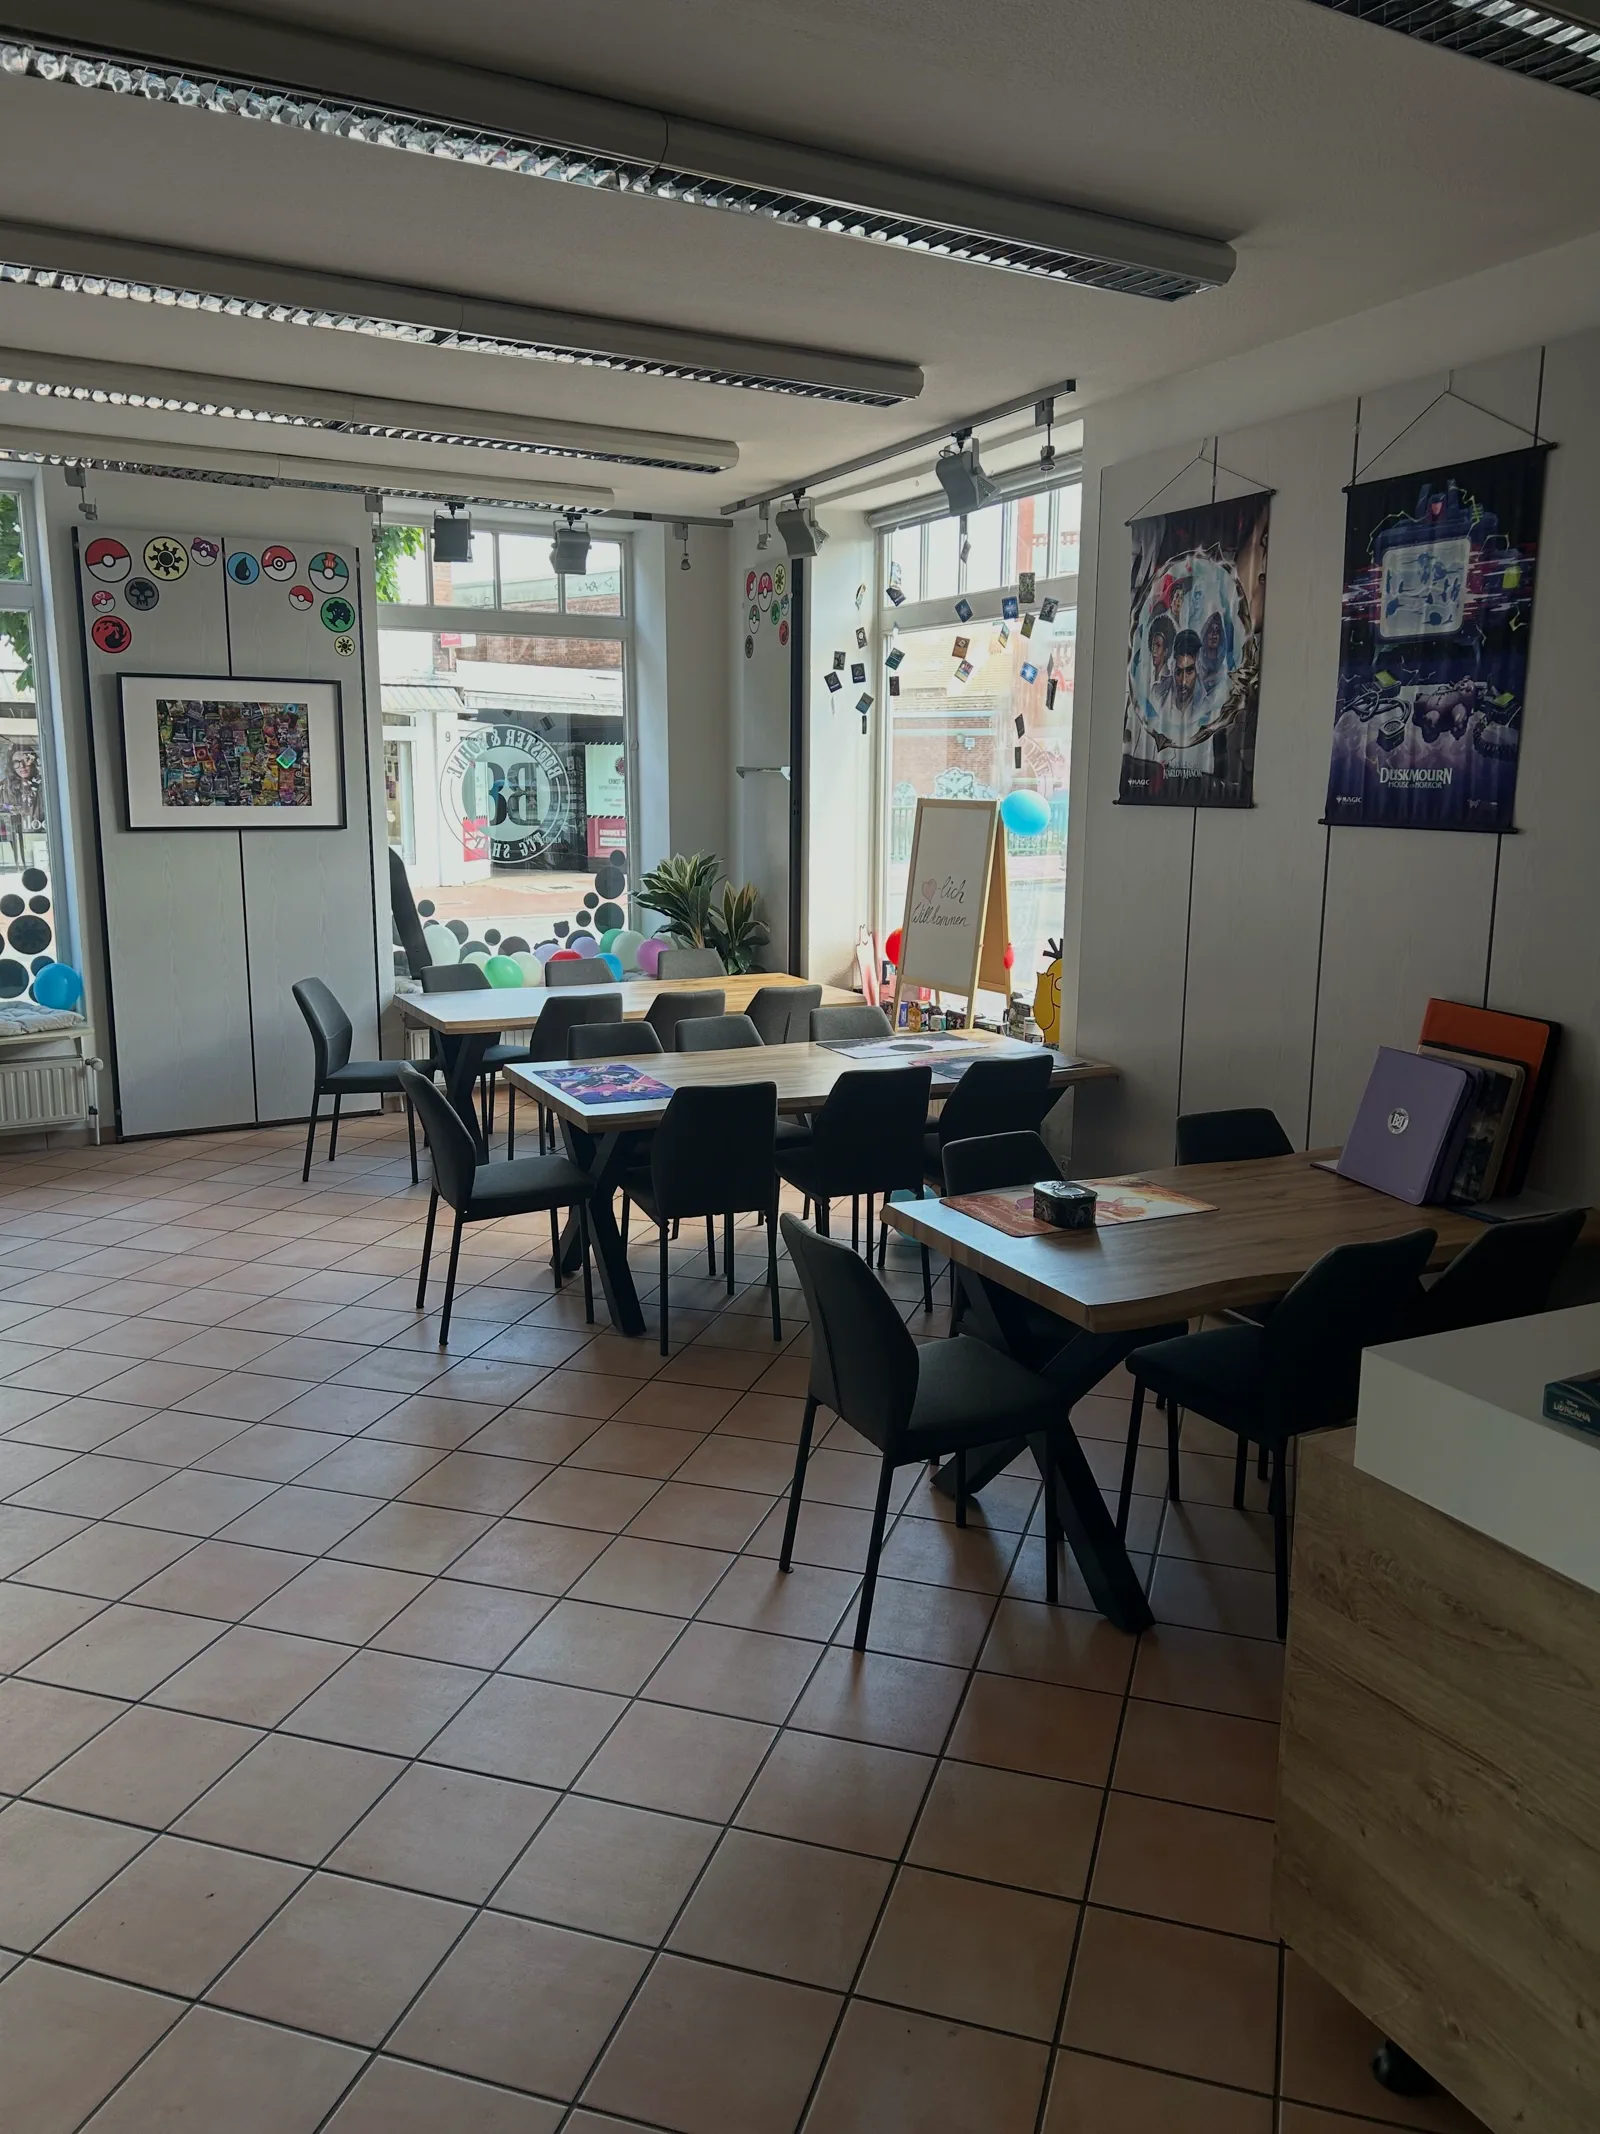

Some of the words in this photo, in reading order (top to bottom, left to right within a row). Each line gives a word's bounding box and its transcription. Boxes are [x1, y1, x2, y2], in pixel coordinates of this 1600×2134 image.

[445, 731, 451, 742] 9
[1379, 767, 1453, 785] DUSKMOURN
[1415, 781, 1443, 789] HORROR
